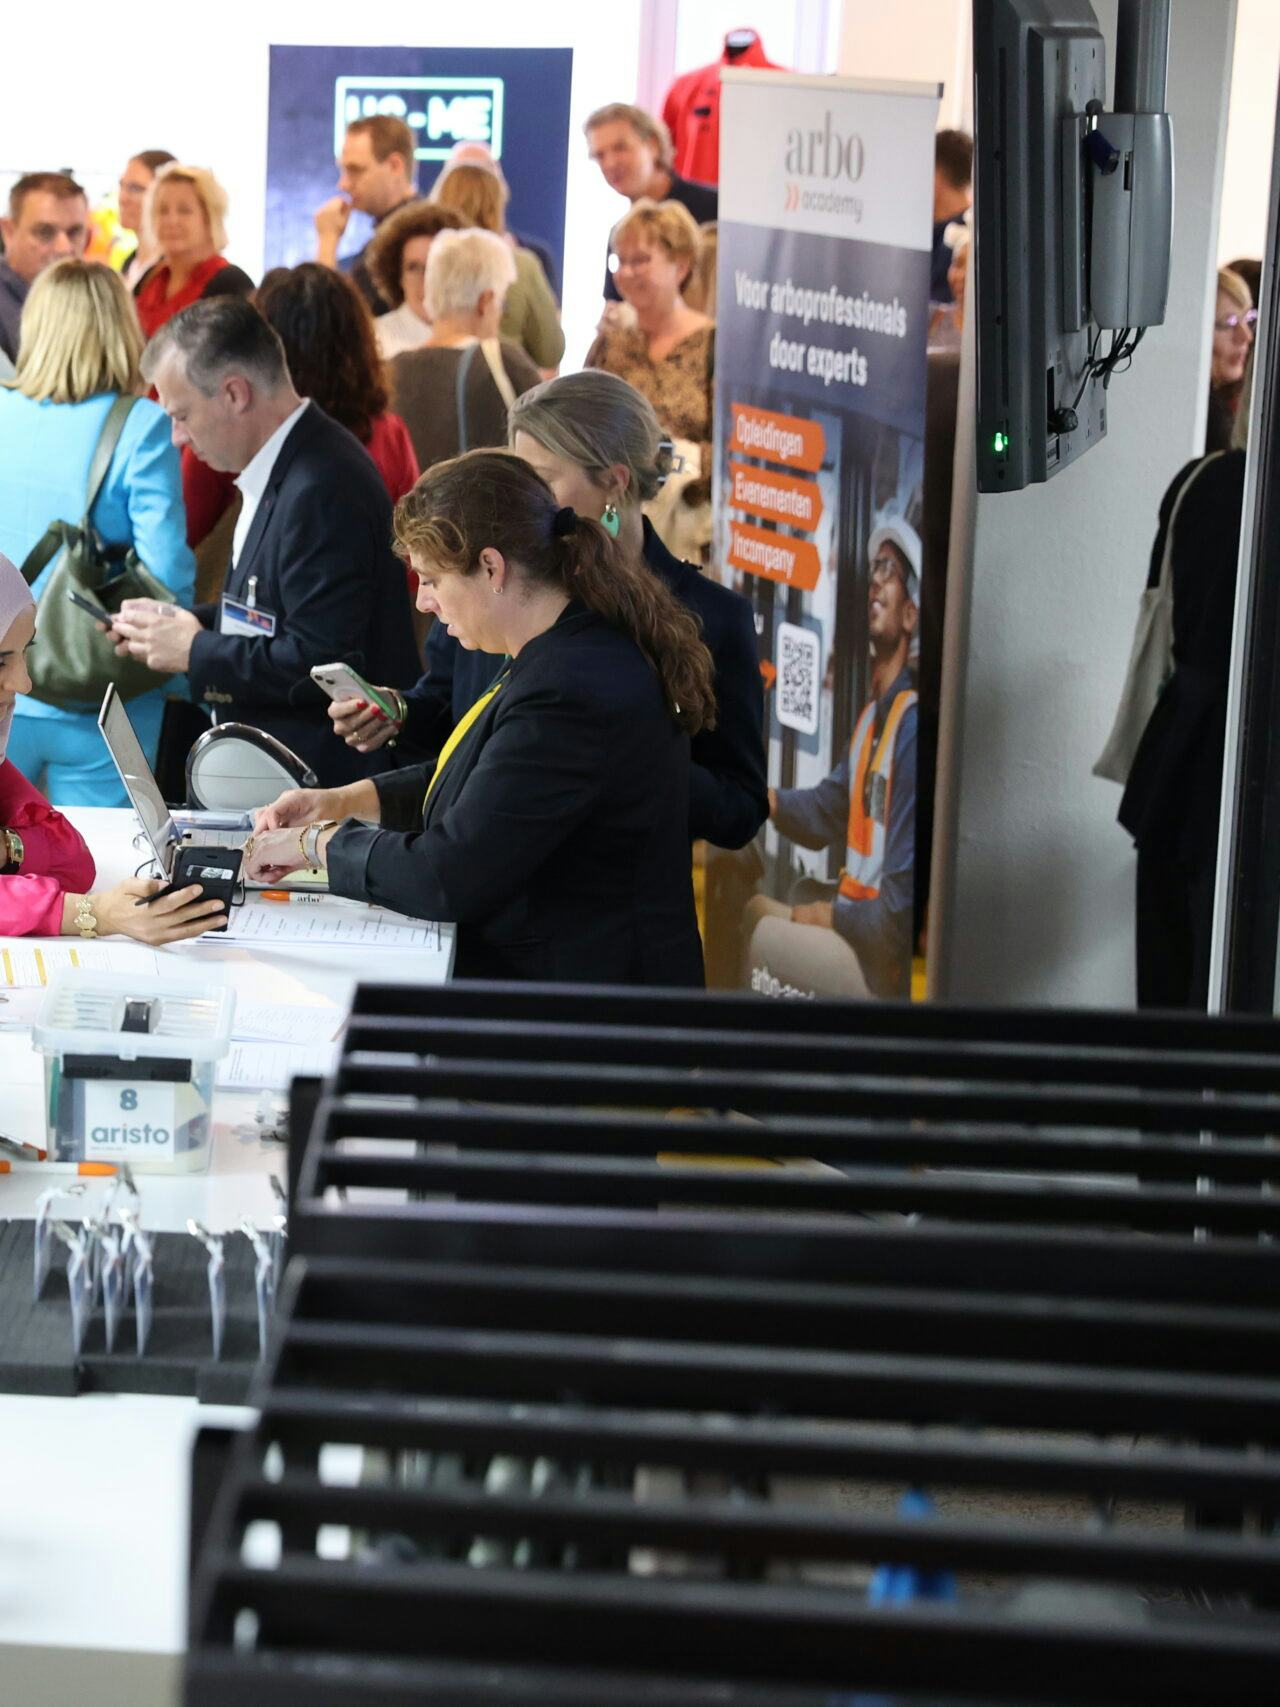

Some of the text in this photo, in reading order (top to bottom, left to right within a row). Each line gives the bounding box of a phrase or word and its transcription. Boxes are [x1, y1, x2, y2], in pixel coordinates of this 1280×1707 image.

[785, 110, 865, 183] arbo
[802, 189, 864, 224] academy
[735, 269, 908, 338] Voor arboprofessionals
[770, 331, 868, 387] door experts
[736, 413, 804, 460] Opleidingen
[735, 471, 812, 520] Evenementen
[733, 531, 796, 580] Incompany
[120, 1088, 138, 1111] 8
[91, 1122, 170, 1144] aristo
